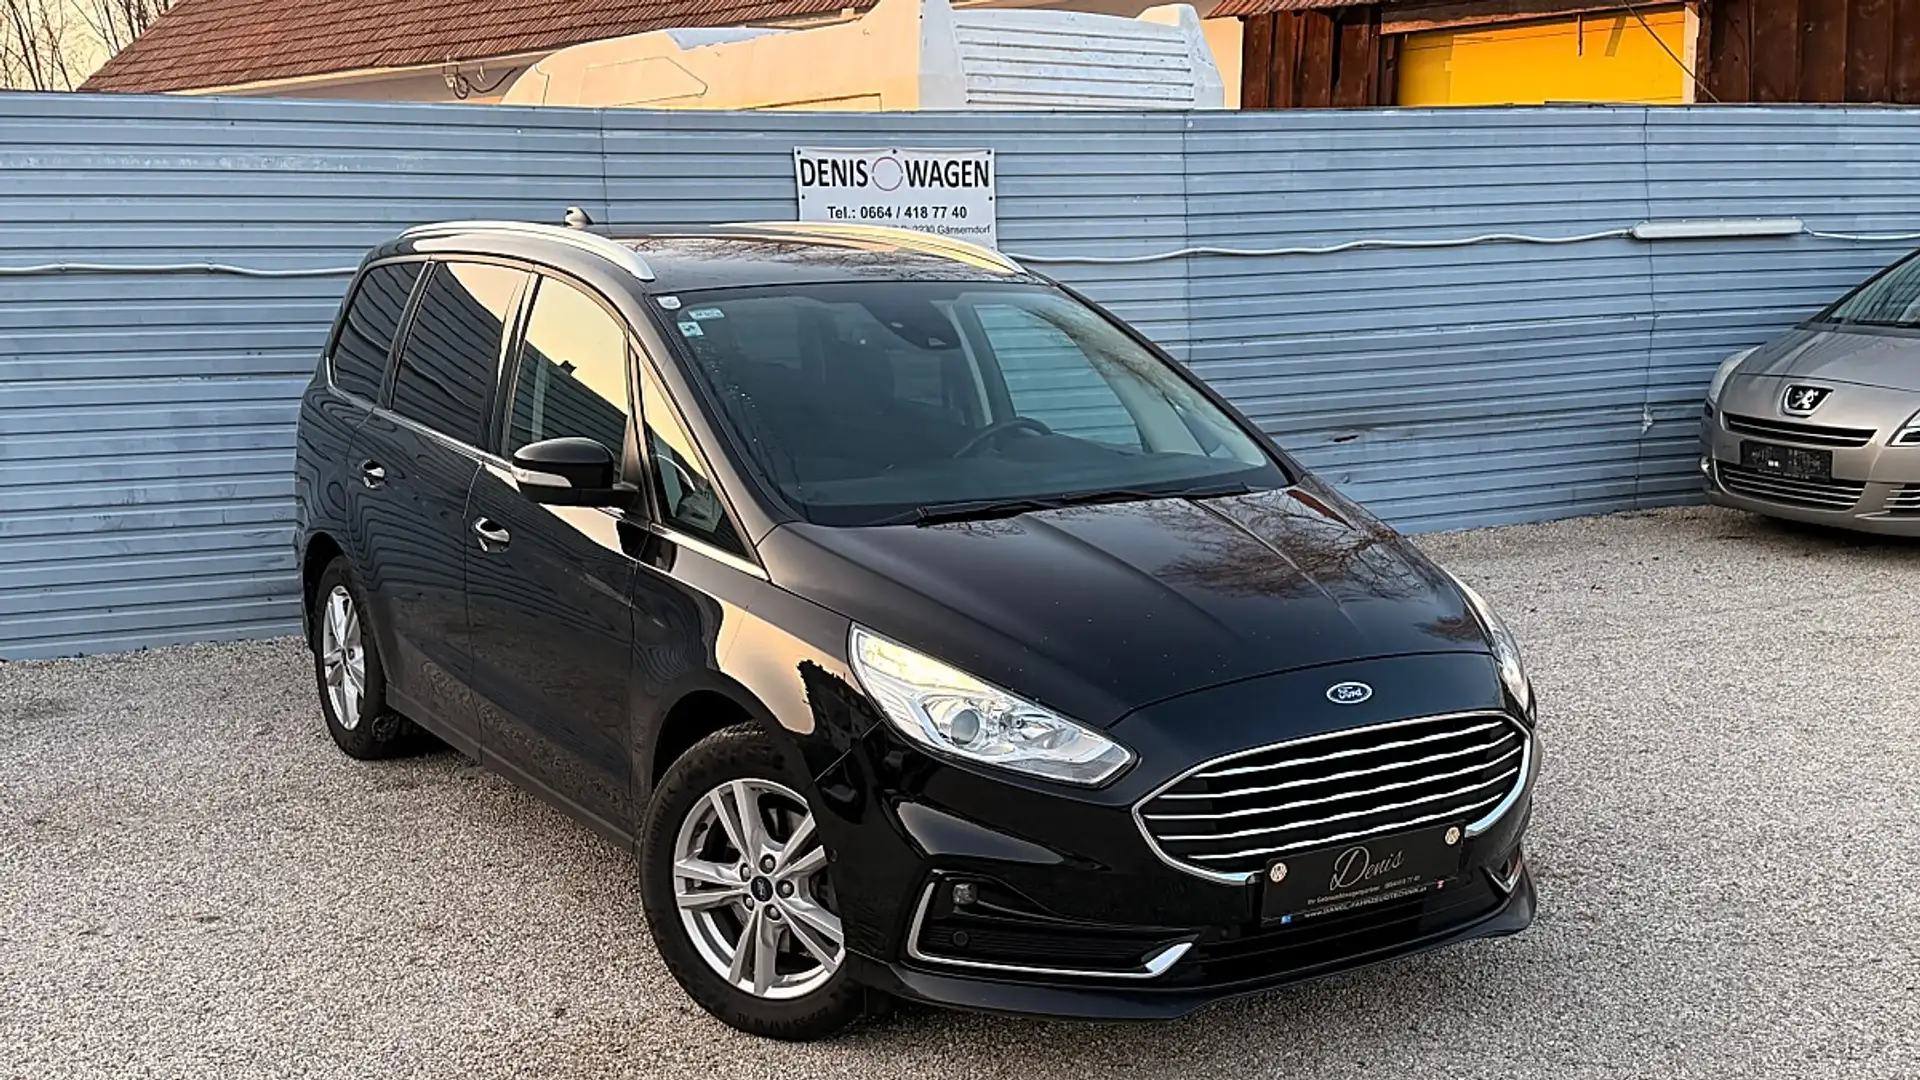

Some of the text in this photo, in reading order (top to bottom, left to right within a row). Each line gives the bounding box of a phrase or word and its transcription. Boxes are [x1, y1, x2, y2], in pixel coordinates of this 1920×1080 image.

[800, 158, 990, 188] DENIS WAGEN
[827, 206, 968, 219] Tel.: 0664 / 418 77 40
[1337, 686, 1363, 700] Ford
[1329, 846, 1405, 891] Denis
